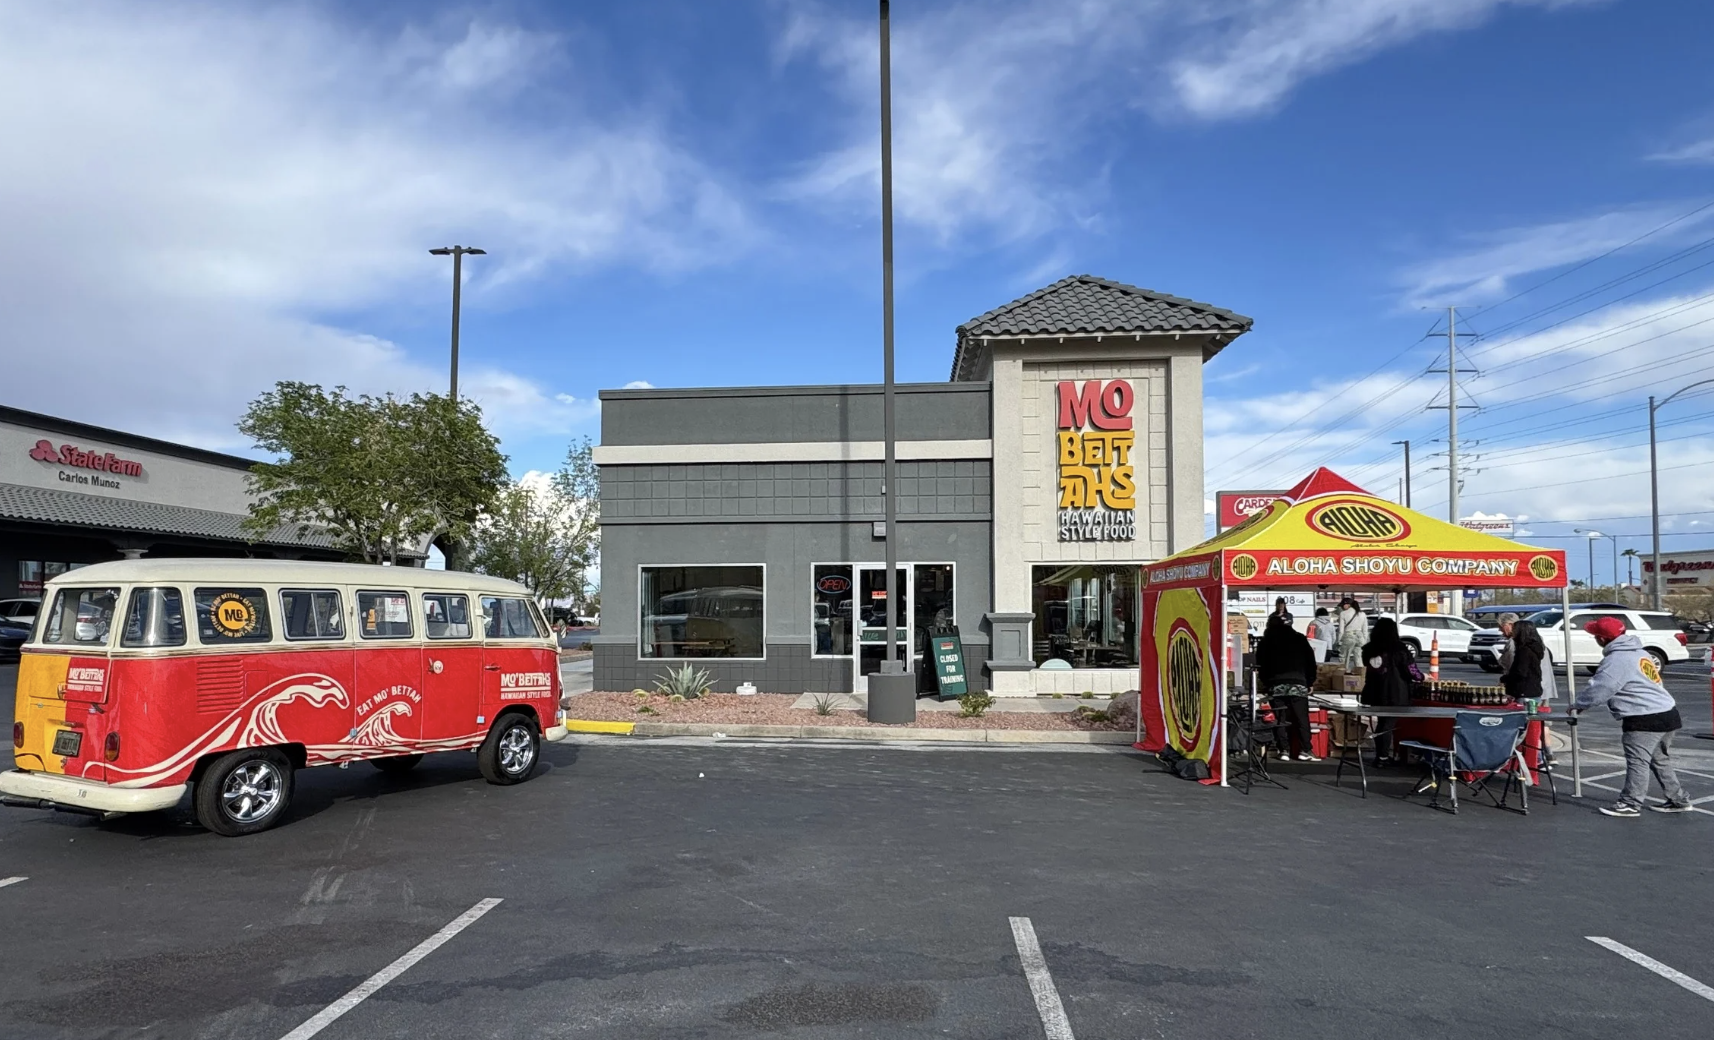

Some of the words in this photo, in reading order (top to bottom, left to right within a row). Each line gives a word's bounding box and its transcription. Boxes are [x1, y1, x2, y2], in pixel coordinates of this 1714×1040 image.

[1058, 379, 1134, 430] MO
[1058, 431, 1135, 465] BETT
[58, 444, 103, 470] State
[103, 452, 143, 477] Farm
[58, 470, 89, 484] Carlos
[91, 475, 120, 489] Munoz
[1060, 466, 1135, 509] AHS
[1060, 511, 1135, 525] HAWAIIAN
[1319, 506, 1396, 538] ALOHA
[1060, 525, 1101, 539] STYLE
[1103, 525, 1136, 539] FOOD
[1232, 556, 1256, 577] ALOHA
[1267, 557, 1338, 575] ALOHA
[1342, 557, 1412, 574] SHOYU
[1416, 557, 1518, 576] COMPANY
[819, 579, 848, 590] OPEN
[940, 654, 959, 663] CLOSED
[945, 664, 956, 673] FOR
[940, 674, 964, 684] TRAINING
[356, 699, 373, 716] EAT
[372, 688, 389, 704] MO'
[391, 685, 421, 703] BETTAH
